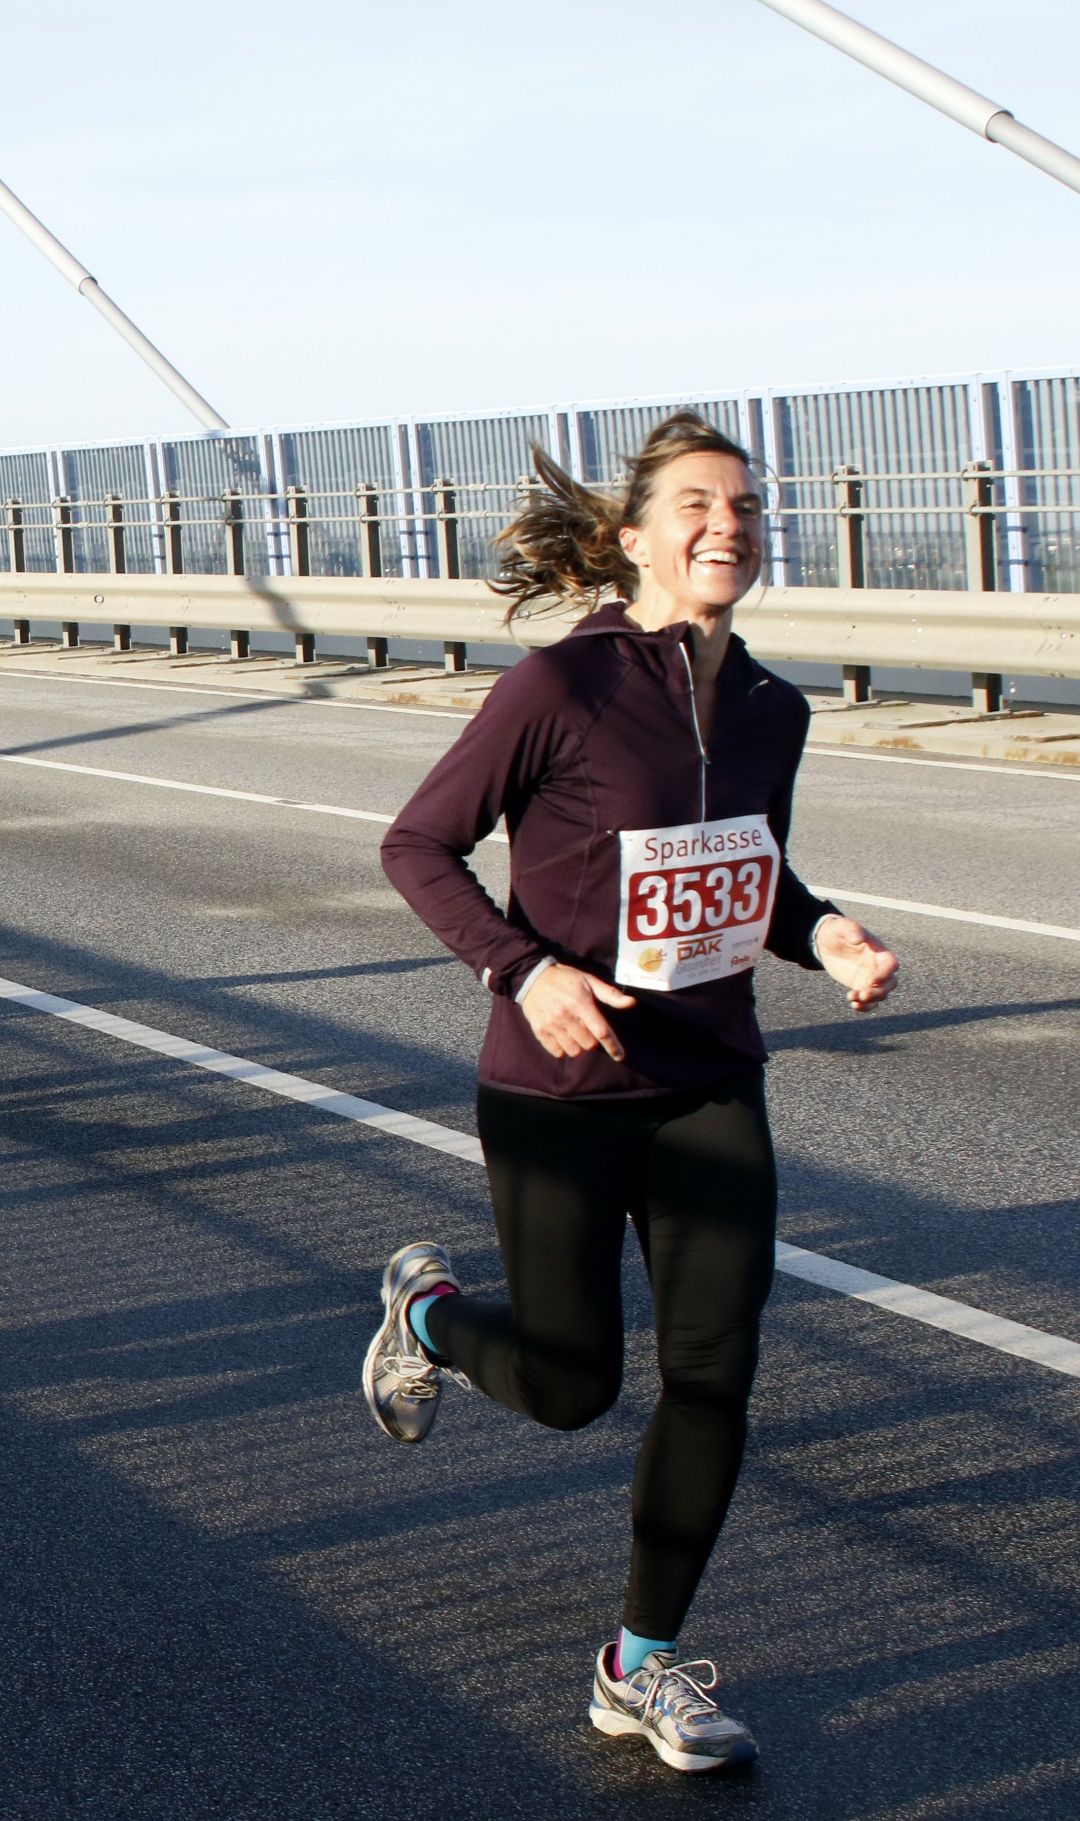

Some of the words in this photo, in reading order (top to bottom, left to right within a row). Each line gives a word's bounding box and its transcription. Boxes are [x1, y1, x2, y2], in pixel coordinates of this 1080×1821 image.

[644, 829, 762, 865] Sparkasse
[636, 862, 762, 936] 3533
[677, 934, 724, 961] DAK
